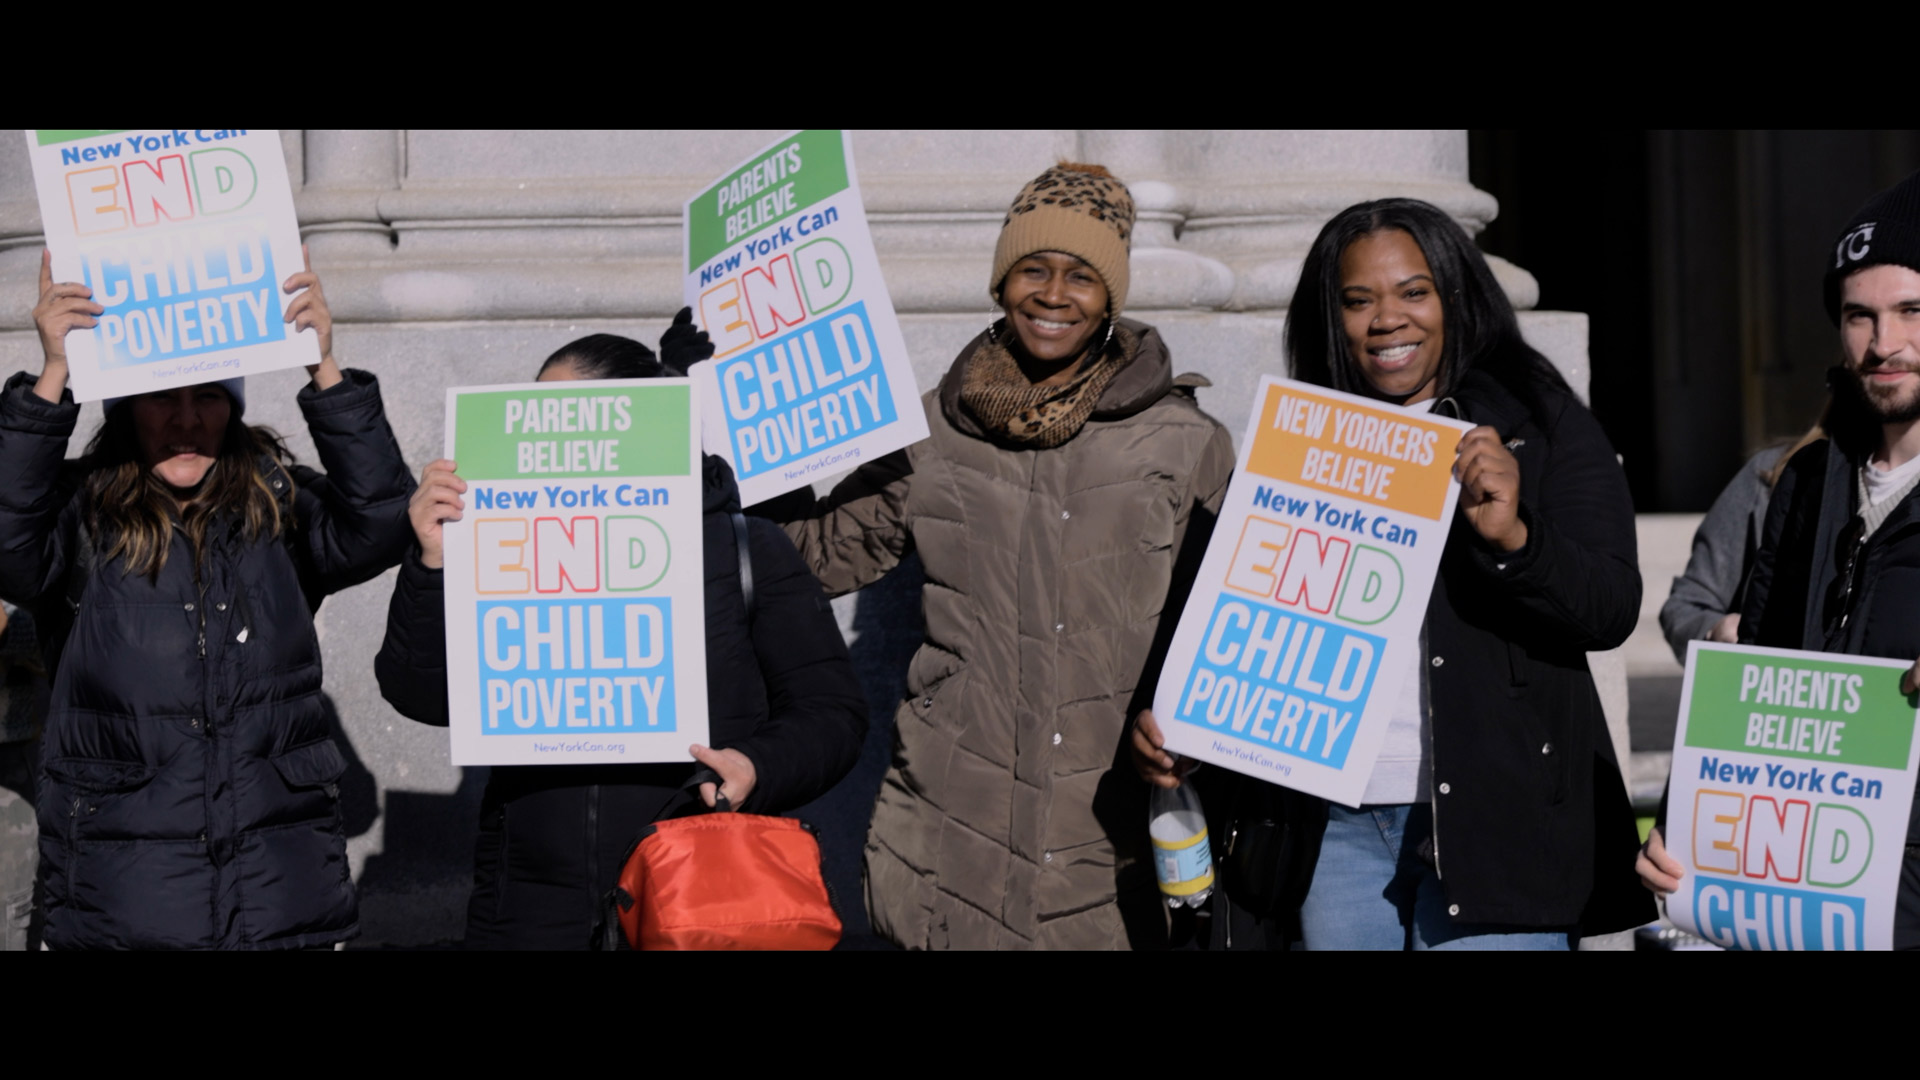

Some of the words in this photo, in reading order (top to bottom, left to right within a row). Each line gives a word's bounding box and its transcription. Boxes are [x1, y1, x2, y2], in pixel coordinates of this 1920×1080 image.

[61, 141, 121, 165] New
[126, 130, 191, 154] York
[718, 142, 802, 216] PARENTS
[65, 147, 258, 237] END
[726, 182, 797, 244] BELIEVE
[90, 222, 267, 309] CHILD
[700, 251, 742, 287] New
[745, 225, 794, 261] York
[797, 206, 839, 236] Can
[100, 288, 272, 363] POVERTY
[700, 237, 853, 359] END
[152, 357, 241, 380] NewYorkCan.org
[723, 312, 873, 421] CHILD
[505, 395, 632, 434] PARENTS
[735, 373, 883, 473] POVERTY
[1274, 394, 1330, 440] NEW
[1333, 411, 1439, 467] YORKERS
[517, 439, 620, 474] BELIEVE
[784, 446, 861, 482] NewYorkCan.org
[1301, 447, 1396, 501] BELIEVE
[475, 487, 538, 510] New
[544, 485, 609, 508] York
[615, 486, 670, 506] Can
[1253, 485, 1310, 517] New
[1313, 500, 1368, 535] York
[1371, 516, 1419, 548] Can
[474, 515, 671, 595] END
[1224, 514, 1405, 626] END
[483, 603, 664, 671] CHILD
[1204, 601, 1375, 703] CHILD
[486, 676, 665, 729] POVERTY
[1183, 668, 1353, 760] POVERTY
[1739, 664, 1864, 714] PARENTS
[534, 741, 626, 754] NewYorkCan.org
[1212, 740, 1292, 776] NewYorkCan.org
[1745, 712, 1846, 756] BELIEVE
[1699, 756, 1760, 785] New
[1764, 763, 1826, 794] York
[1830, 771, 1883, 800] Can
[1692, 788, 1874, 889] END
